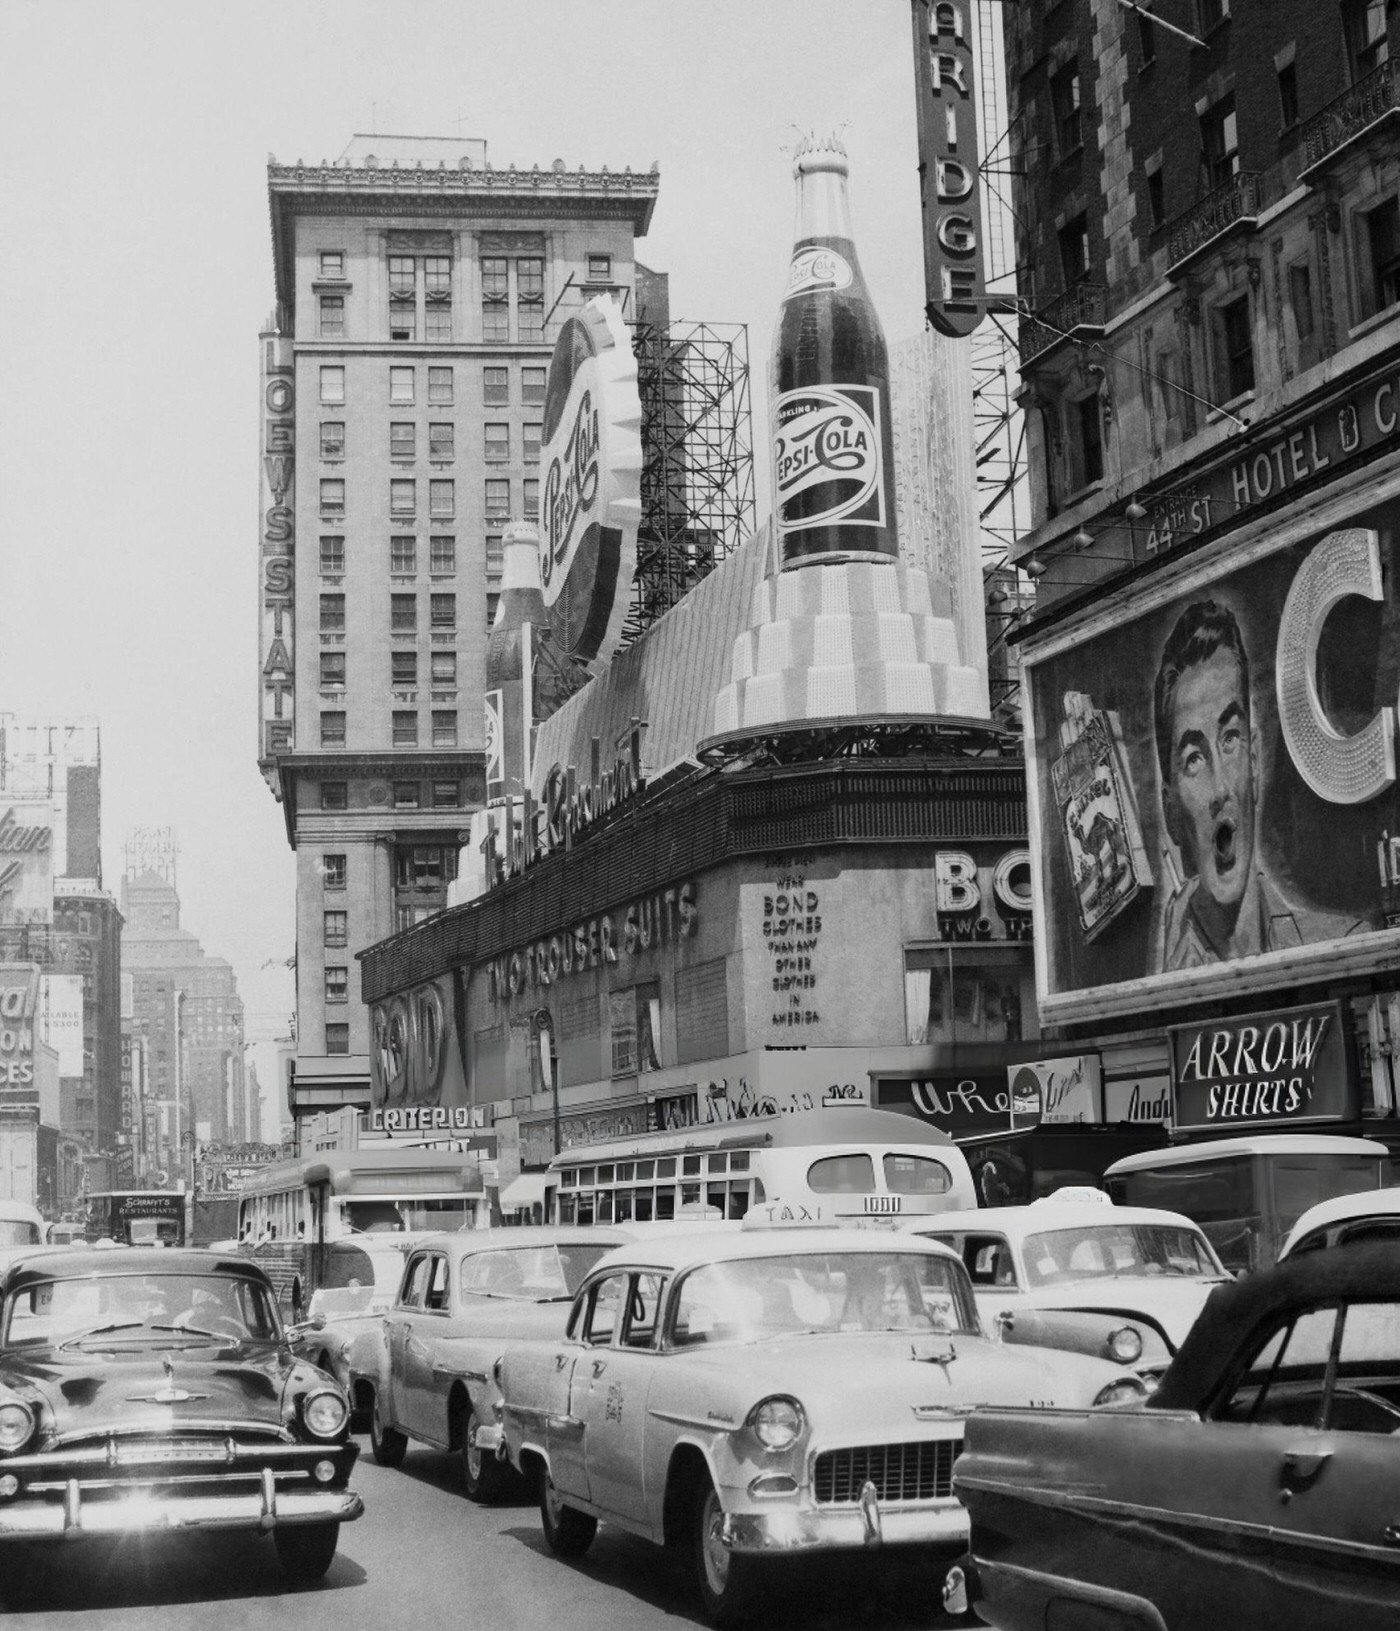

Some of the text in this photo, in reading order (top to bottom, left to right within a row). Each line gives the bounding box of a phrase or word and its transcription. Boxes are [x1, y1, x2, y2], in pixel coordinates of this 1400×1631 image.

[1232, 377, 1400, 511] HOTEL C
[1154, 485, 1199, 520] ENTRANCE
[1145, 494, 1212, 556] 44TH ST
[263, 341, 294, 756] LOEW'S STATE
[1276, 527, 1400, 804] C
[764, 891, 819, 917] BOND
[525, 914, 617, 985] TROUSER
[624, 883, 696, 955] SUITS
[763, 916, 822, 937] CLOTHES
[943, 918, 992, 935] TWO
[768, 937, 818, 955] THAN ANY
[776, 957, 811, 973] OTHER
[773, 974, 816, 992] CLOTHES
[789, 994, 800, 1008] IN
[772, 1010, 819, 1026] AMERICA
[1179, 1014, 1331, 1083] ARROW
[121, 1040, 132, 1129] HOWARD
[1206, 1077, 1304, 1119] SHIRTS
[373, 1106, 486, 1131] CRITERION
[119, 1207, 178, 1215] RESTAURANTS
[766, 1206, 821, 1221] TAXI
